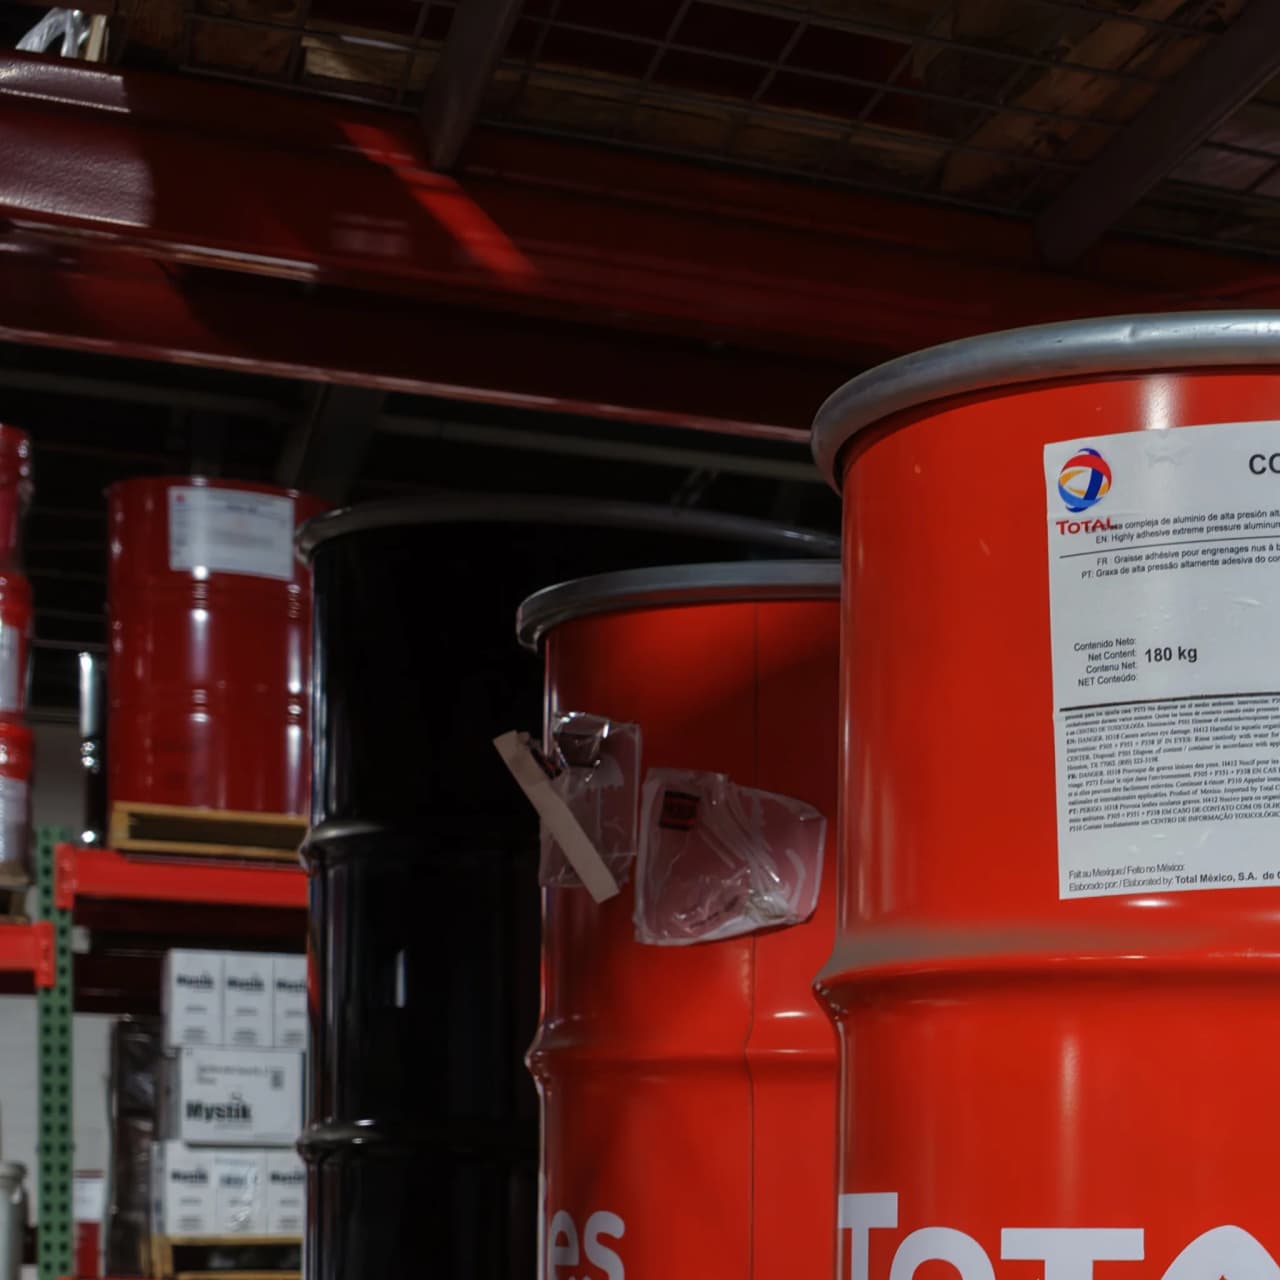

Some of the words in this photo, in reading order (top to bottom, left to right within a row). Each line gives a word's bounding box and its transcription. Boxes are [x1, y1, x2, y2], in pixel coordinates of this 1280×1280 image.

[1125, 519, 1159, 530] compleja
[1161, 517, 1171, 525] de
[1173, 514, 1206, 524] aluminio
[1208, 513, 1218, 522] de
[1220, 512, 1235, 521] alta
[1237, 509, 1267, 521] presión
[1111, 532, 1134, 543] Highly
[1136, 529, 1170, 540] adhesive
[1172, 526, 1204, 536] extreme
[1206, 524, 1241, 535] pressure
[1114, 554, 1143, 564] Graisse
[1182, 549, 1199, 559] pour
[1201, 546, 1249, 558] engrenages
[1251, 544, 1266, 552] nus
[1074, 639, 1114, 651] Contenido
[1144, 647, 1172, 663] 180
[1178, 646, 1198, 663] kg
[1086, 664, 1119, 674] Contenu
[1078, 677, 1094, 687] NET
[1175, 874, 1197, 884] Total
[1238, 871, 1257, 881] S.A.
[1263, 871, 1274, 881] de
[186, 1101, 251, 1122] Mystik
